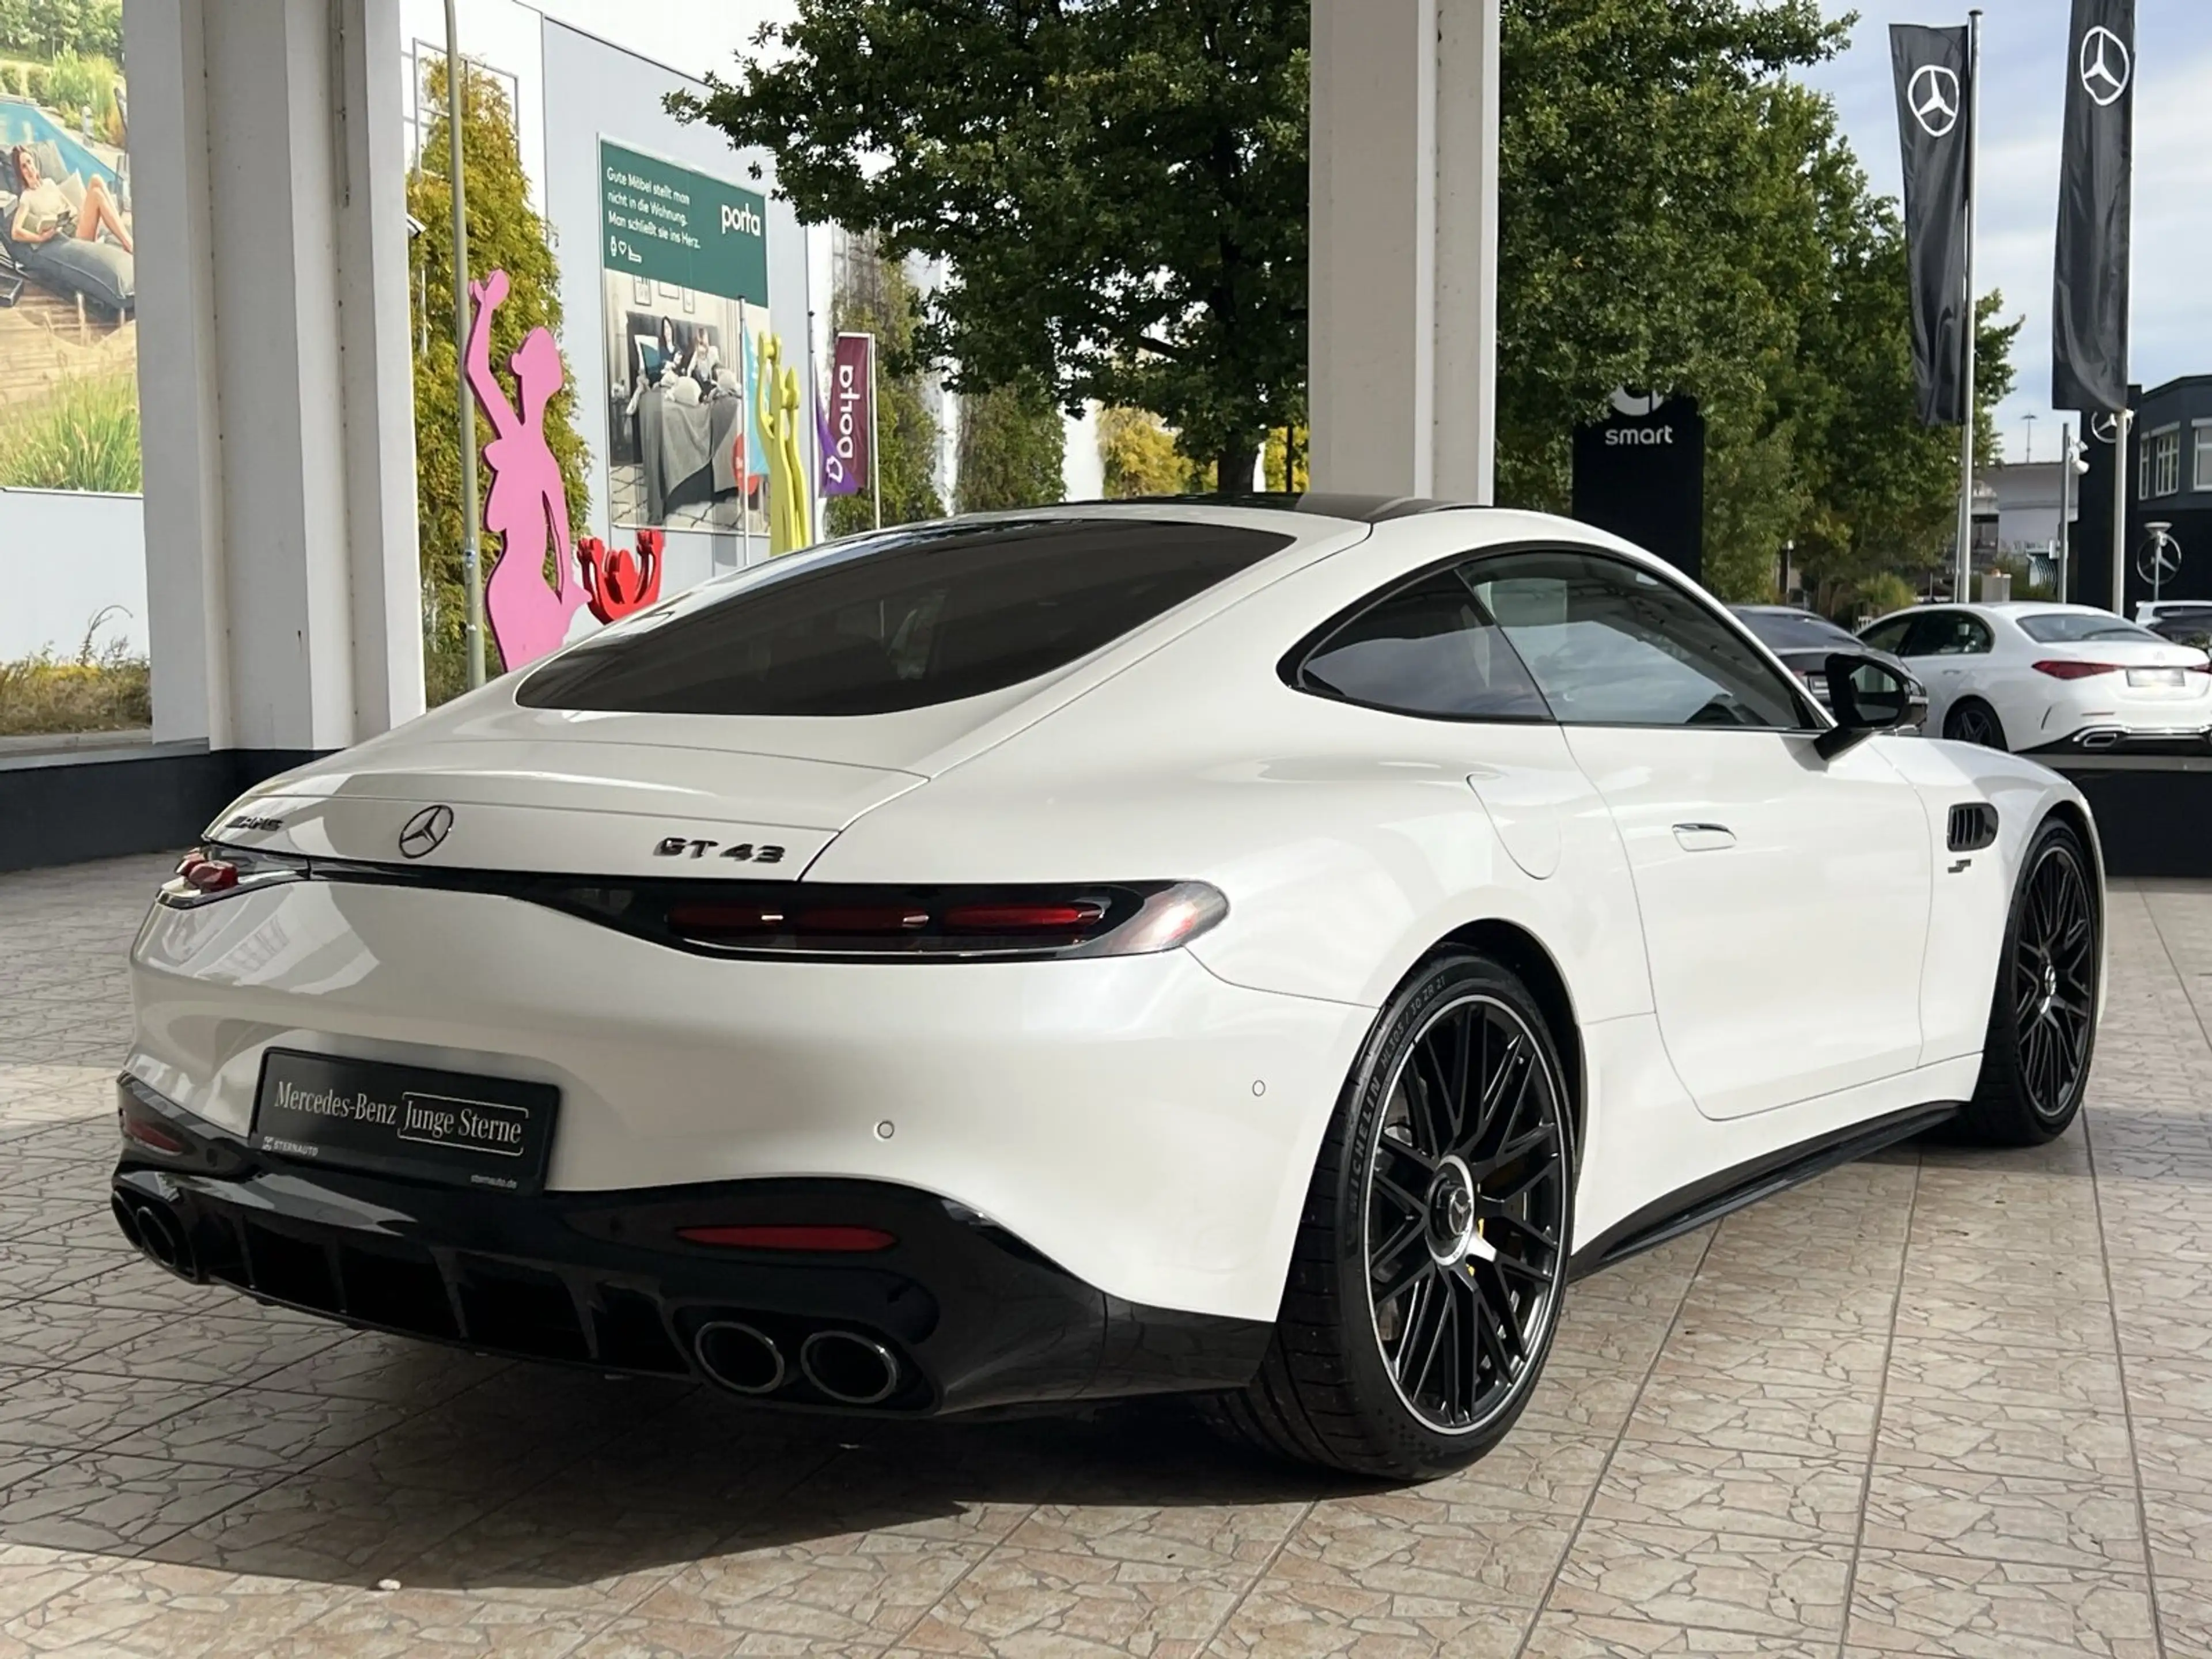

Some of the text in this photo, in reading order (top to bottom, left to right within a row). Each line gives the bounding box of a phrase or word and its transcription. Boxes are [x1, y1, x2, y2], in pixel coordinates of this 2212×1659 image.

[607, 166, 690, 205] Gute Möbel stellt man
[607, 190, 627, 208] nicht
[629, 195, 637, 210] in
[637, 198, 649, 214] die
[608, 210, 700, 249] Man schließt sie ins Herz.
[721, 203, 761, 237] porta
[836, 365, 861, 459] porta
[1605, 425, 1673, 445] smart
[653, 837, 785, 863] GT 43
[274, 1081, 522, 1143] Mercedes-Benz Junge Sterne
[274, 1140, 319, 1157] STERNAUTO
[1350, 1076, 1381, 1213] MICHELIN
